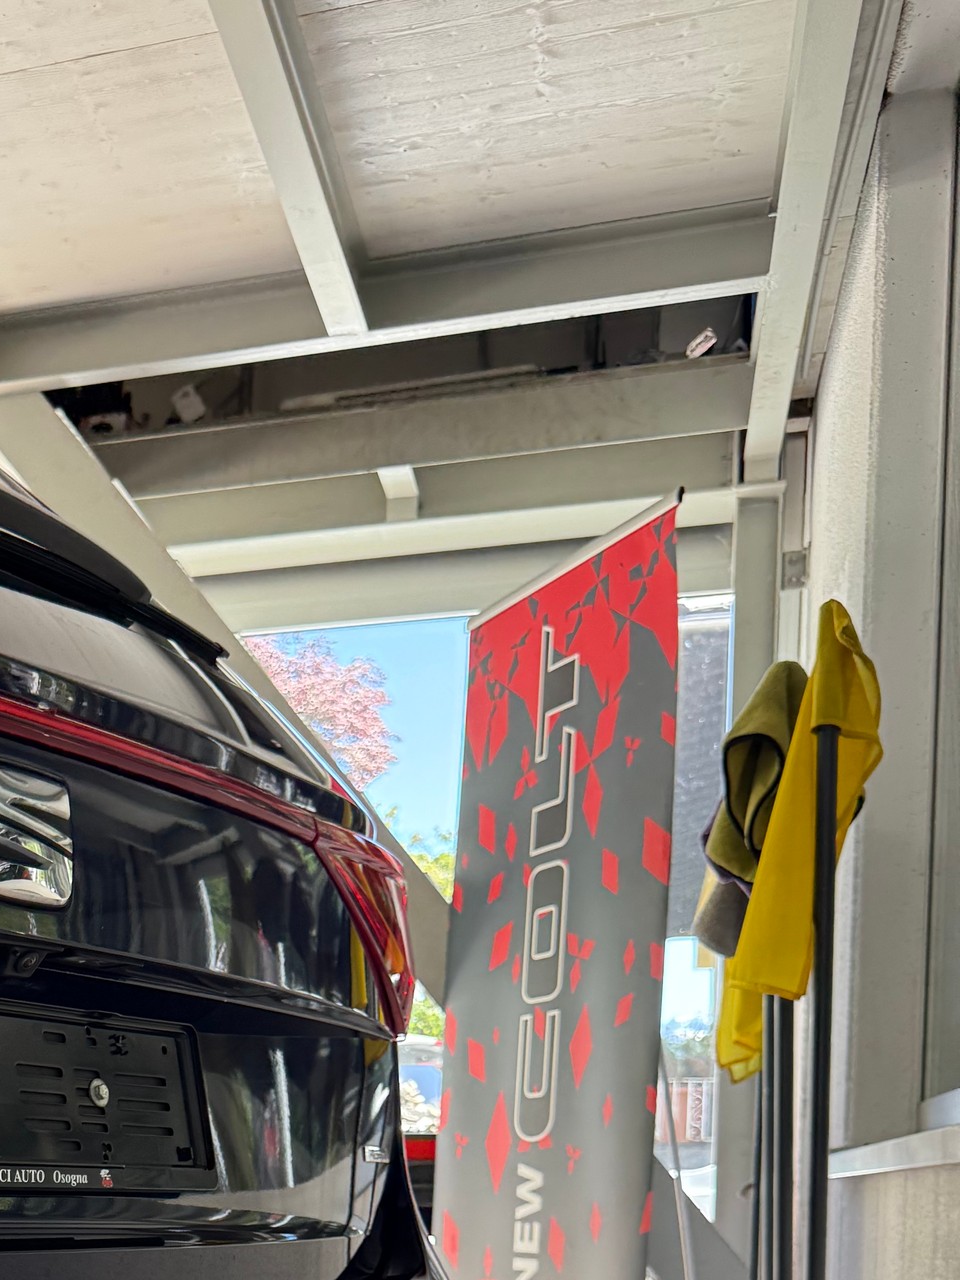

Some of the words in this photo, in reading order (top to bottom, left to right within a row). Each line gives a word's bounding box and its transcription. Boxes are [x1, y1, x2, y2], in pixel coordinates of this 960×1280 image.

[514, 625, 580, 1143] COLT
[14, 1169, 46, 1185] AUTO
[53, 1170, 89, 1186] Osogna
